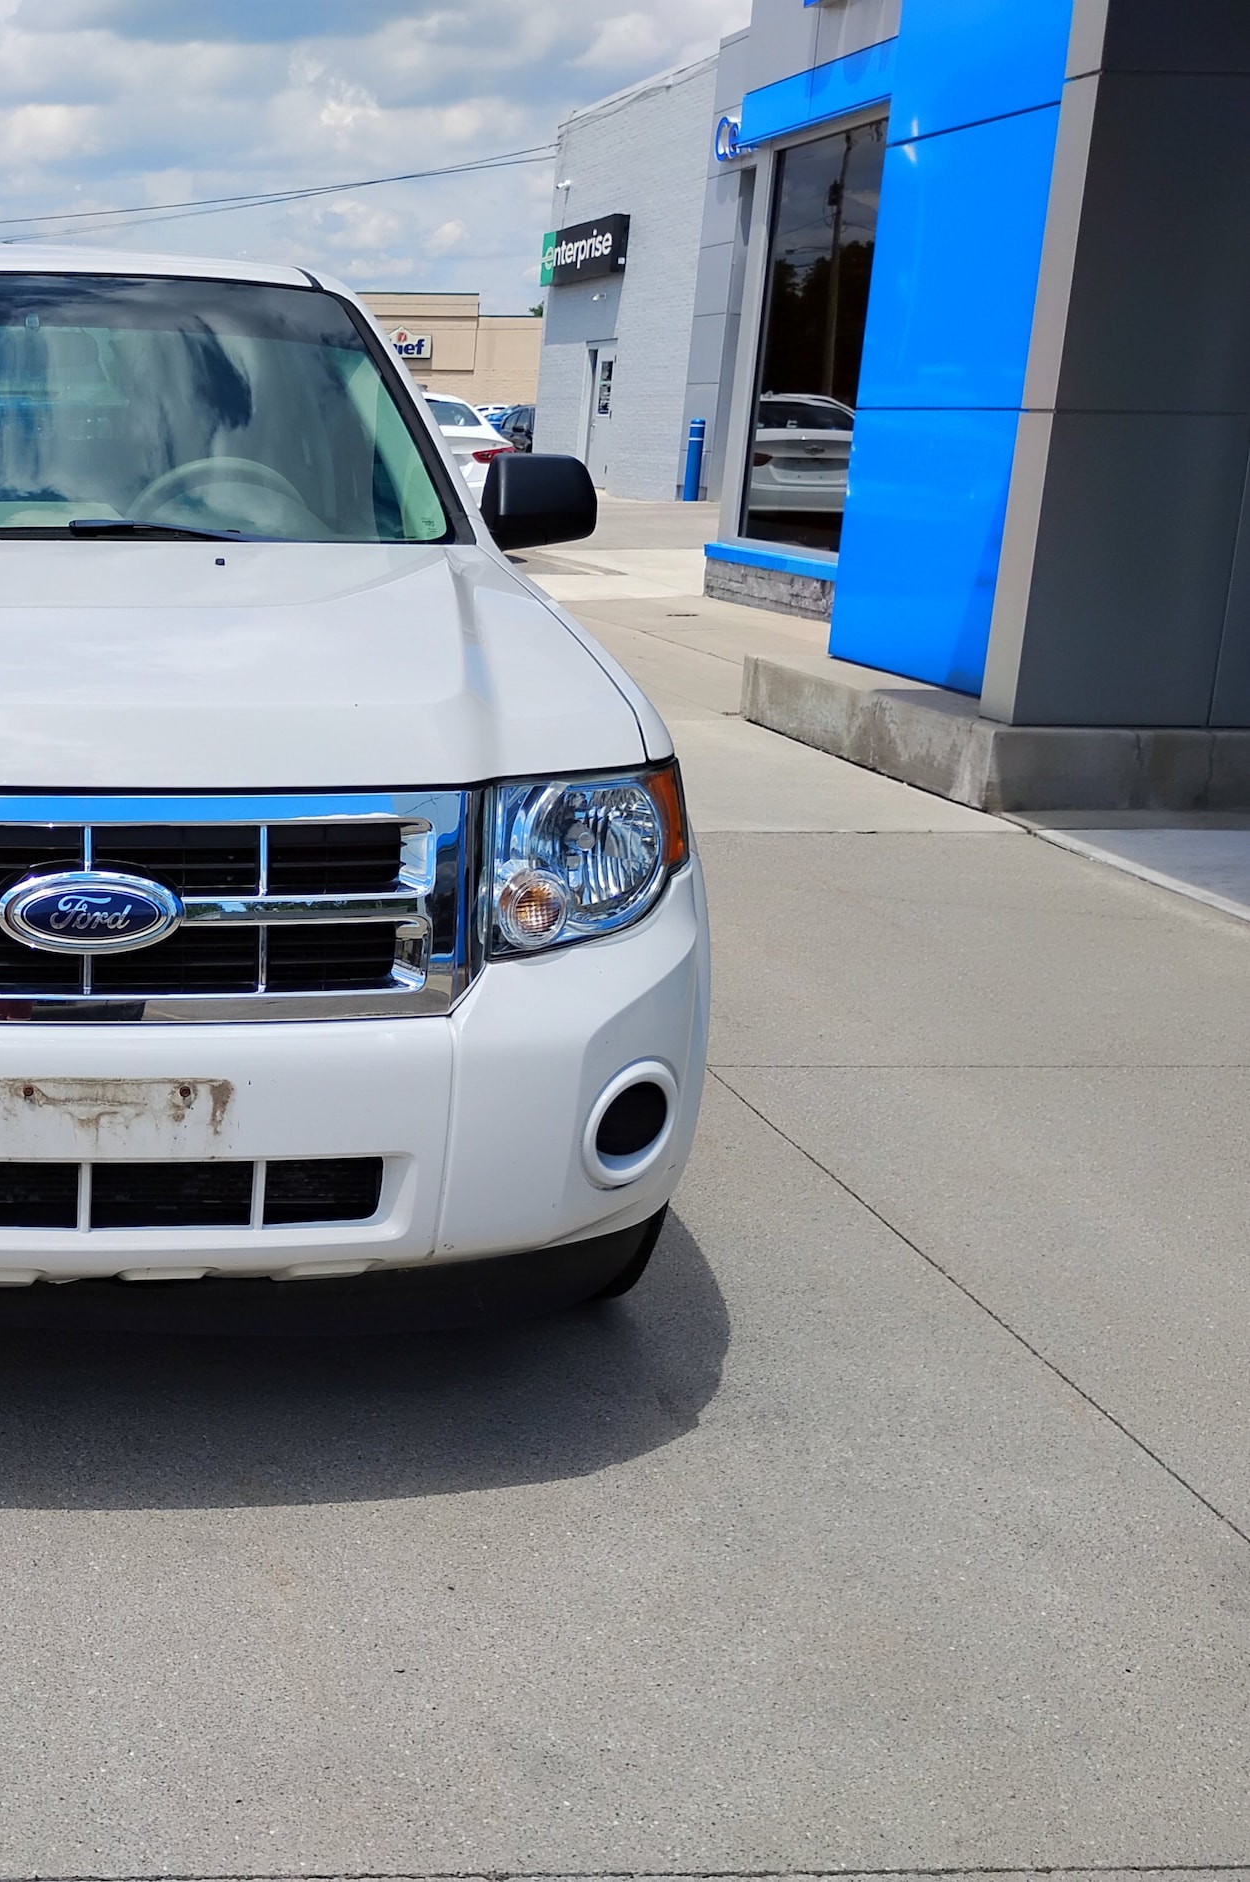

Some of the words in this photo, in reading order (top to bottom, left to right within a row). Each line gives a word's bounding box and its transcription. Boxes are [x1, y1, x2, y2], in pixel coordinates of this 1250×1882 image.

[543, 228, 613, 270] enterprise
[393, 338, 425, 355] ief
[50, 895, 133, 931] Ford
